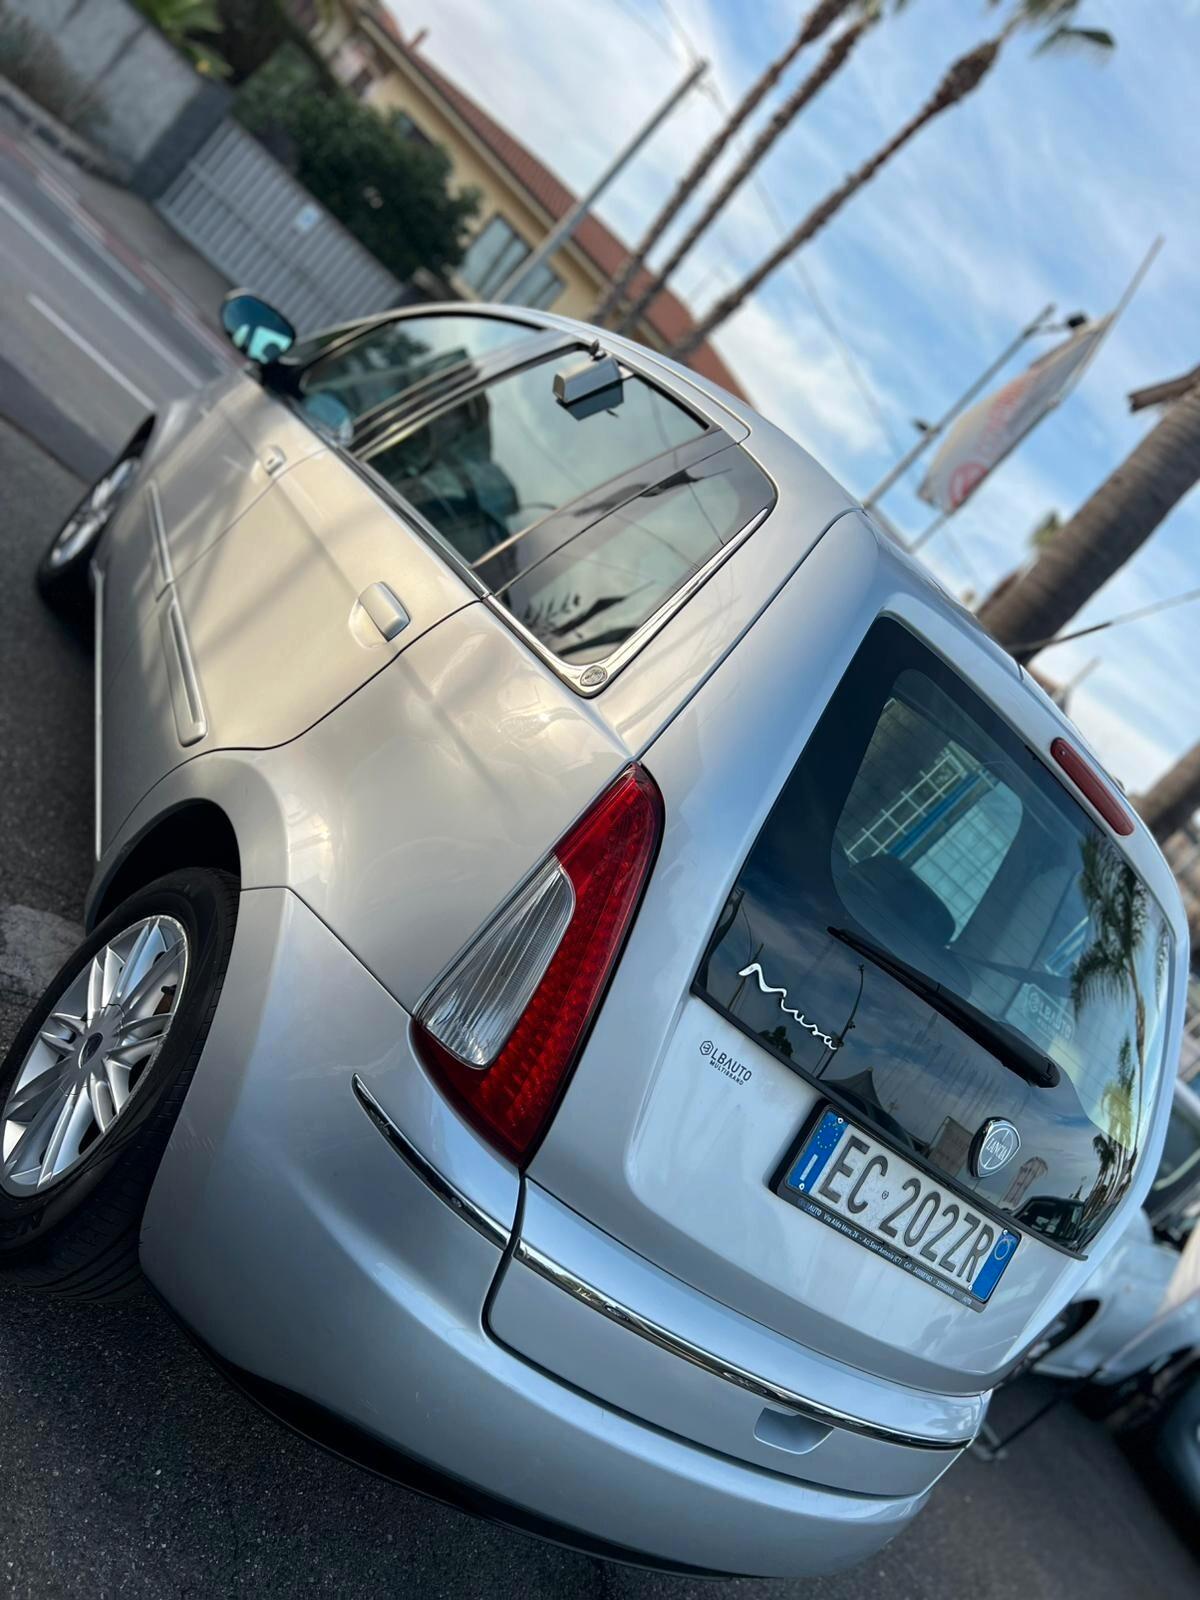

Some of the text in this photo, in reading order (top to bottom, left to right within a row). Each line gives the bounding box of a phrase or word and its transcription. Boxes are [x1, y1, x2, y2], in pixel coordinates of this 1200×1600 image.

[738, 963, 837, 1050] Musa
[709, 1059, 744, 1085] MULTIBRAND
[818, 1135, 995, 1283] EC 202ZR
